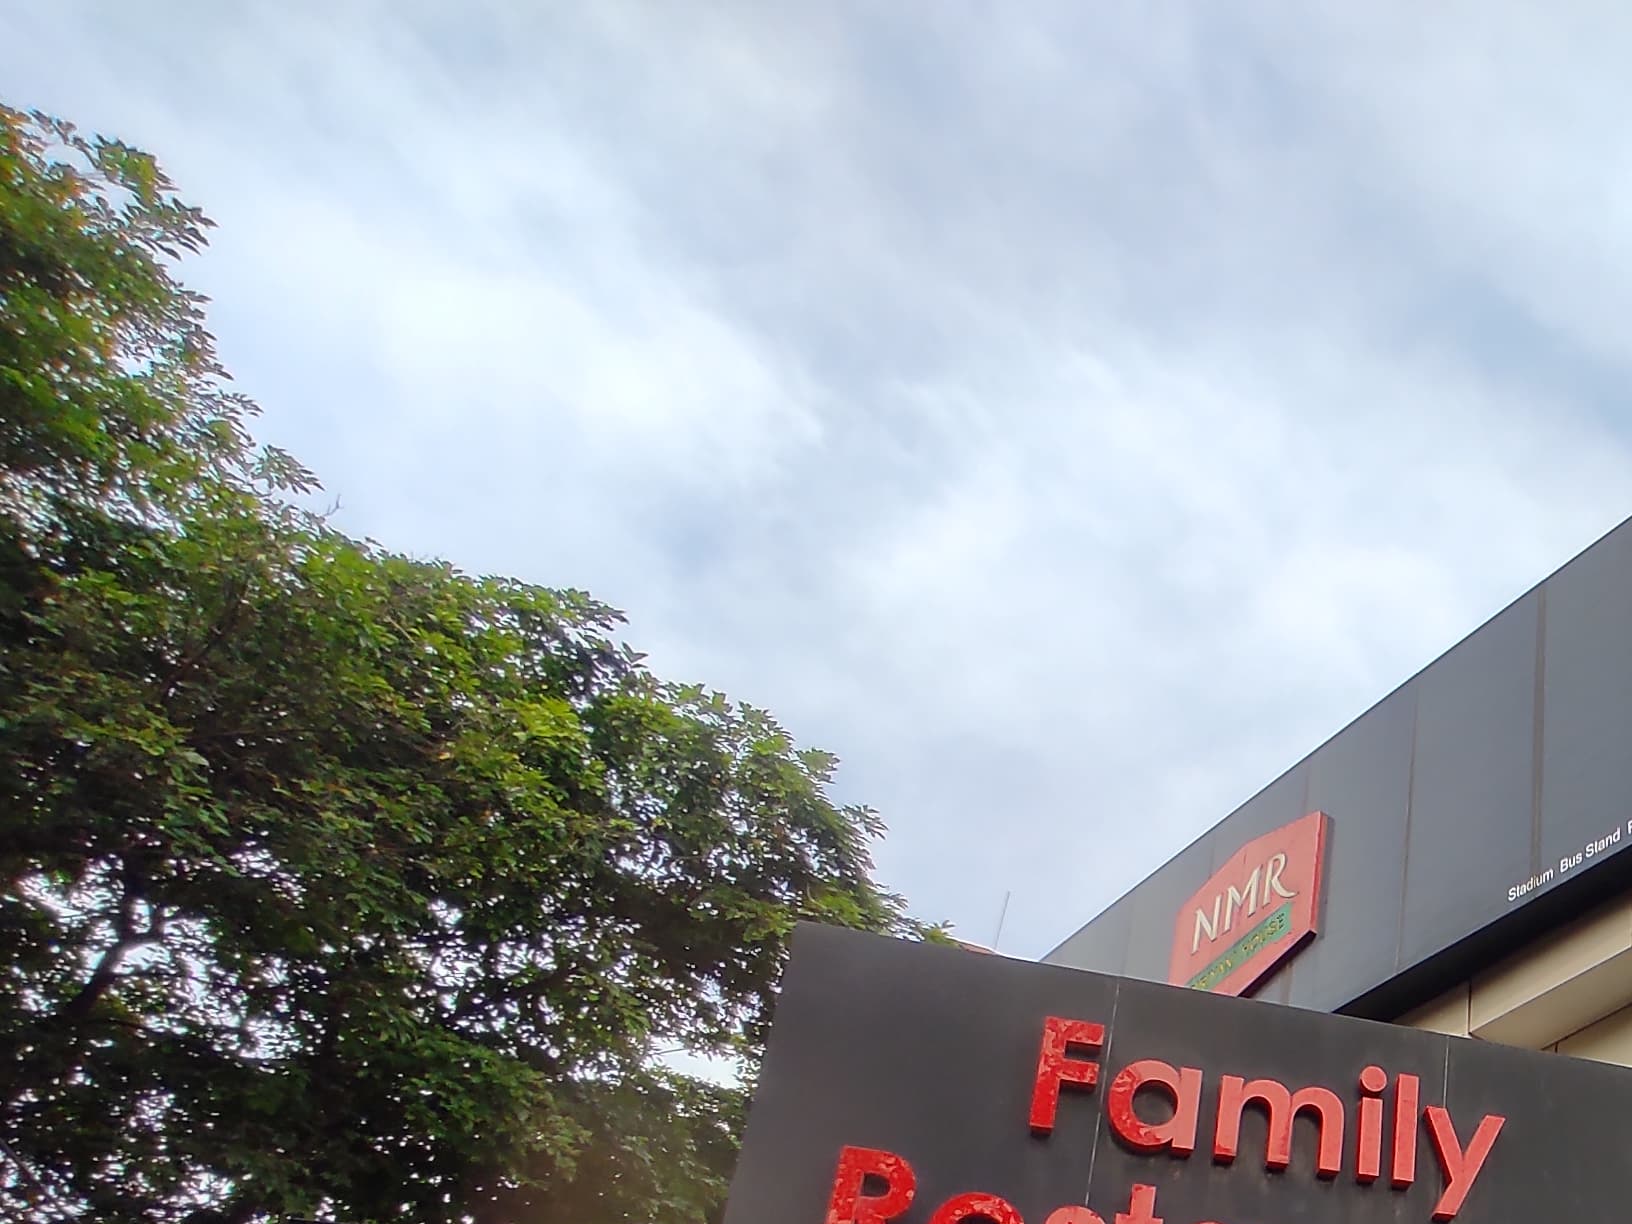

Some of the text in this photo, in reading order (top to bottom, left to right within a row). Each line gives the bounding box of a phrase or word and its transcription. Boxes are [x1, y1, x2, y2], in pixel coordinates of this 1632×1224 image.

[1190, 852, 1299, 955] NMR
[1507, 867, 1554, 902] Stadium
[1560, 851, 1583, 874] Bus
[1585, 825, 1621, 858] Stand
[1029, 1015, 1506, 1223] Family
